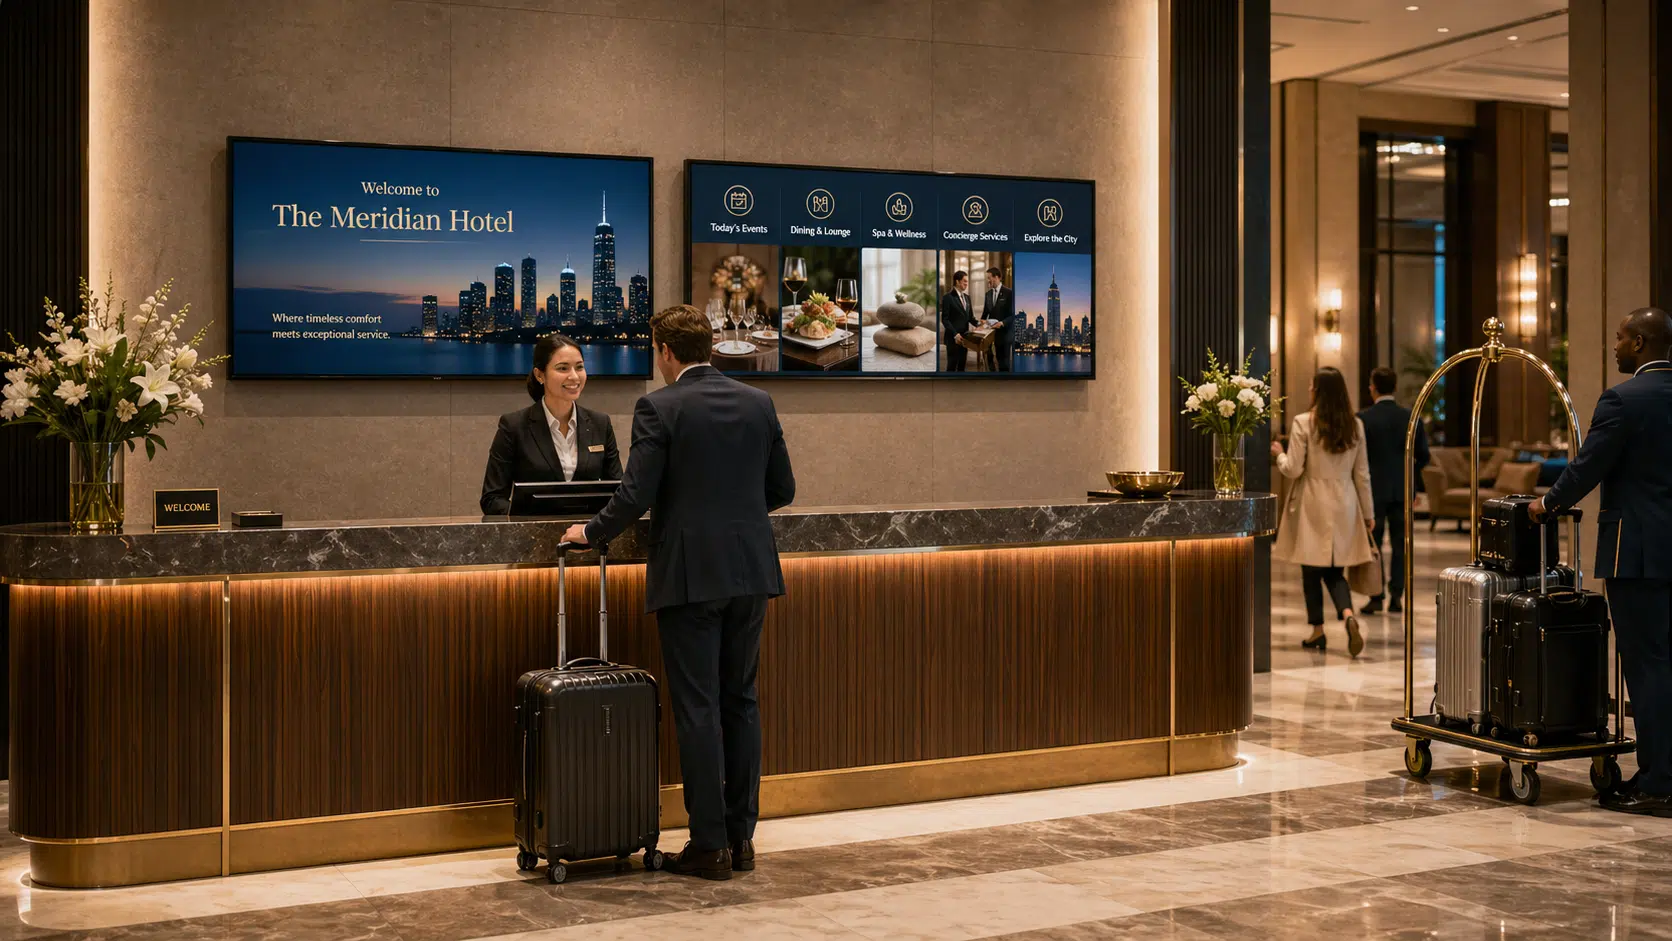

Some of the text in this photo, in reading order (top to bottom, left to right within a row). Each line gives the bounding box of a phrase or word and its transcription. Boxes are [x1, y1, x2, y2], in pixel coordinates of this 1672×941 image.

[361, 181, 440, 197] Welcome to
[272, 204, 514, 233] The Meridian Hotel
[710, 222, 768, 234] Today's Events
[790, 225, 851, 238] Dining & Lounge
[872, 228, 927, 239] Spa & Wellness
[943, 230, 1009, 243] Concierge Services
[1024, 233, 1078, 245] Explore the City
[272, 313, 382, 324] Where timeless comfort
[272, 329, 391, 341] meets exceptional service.
[163, 502, 211, 512] WELCOME
